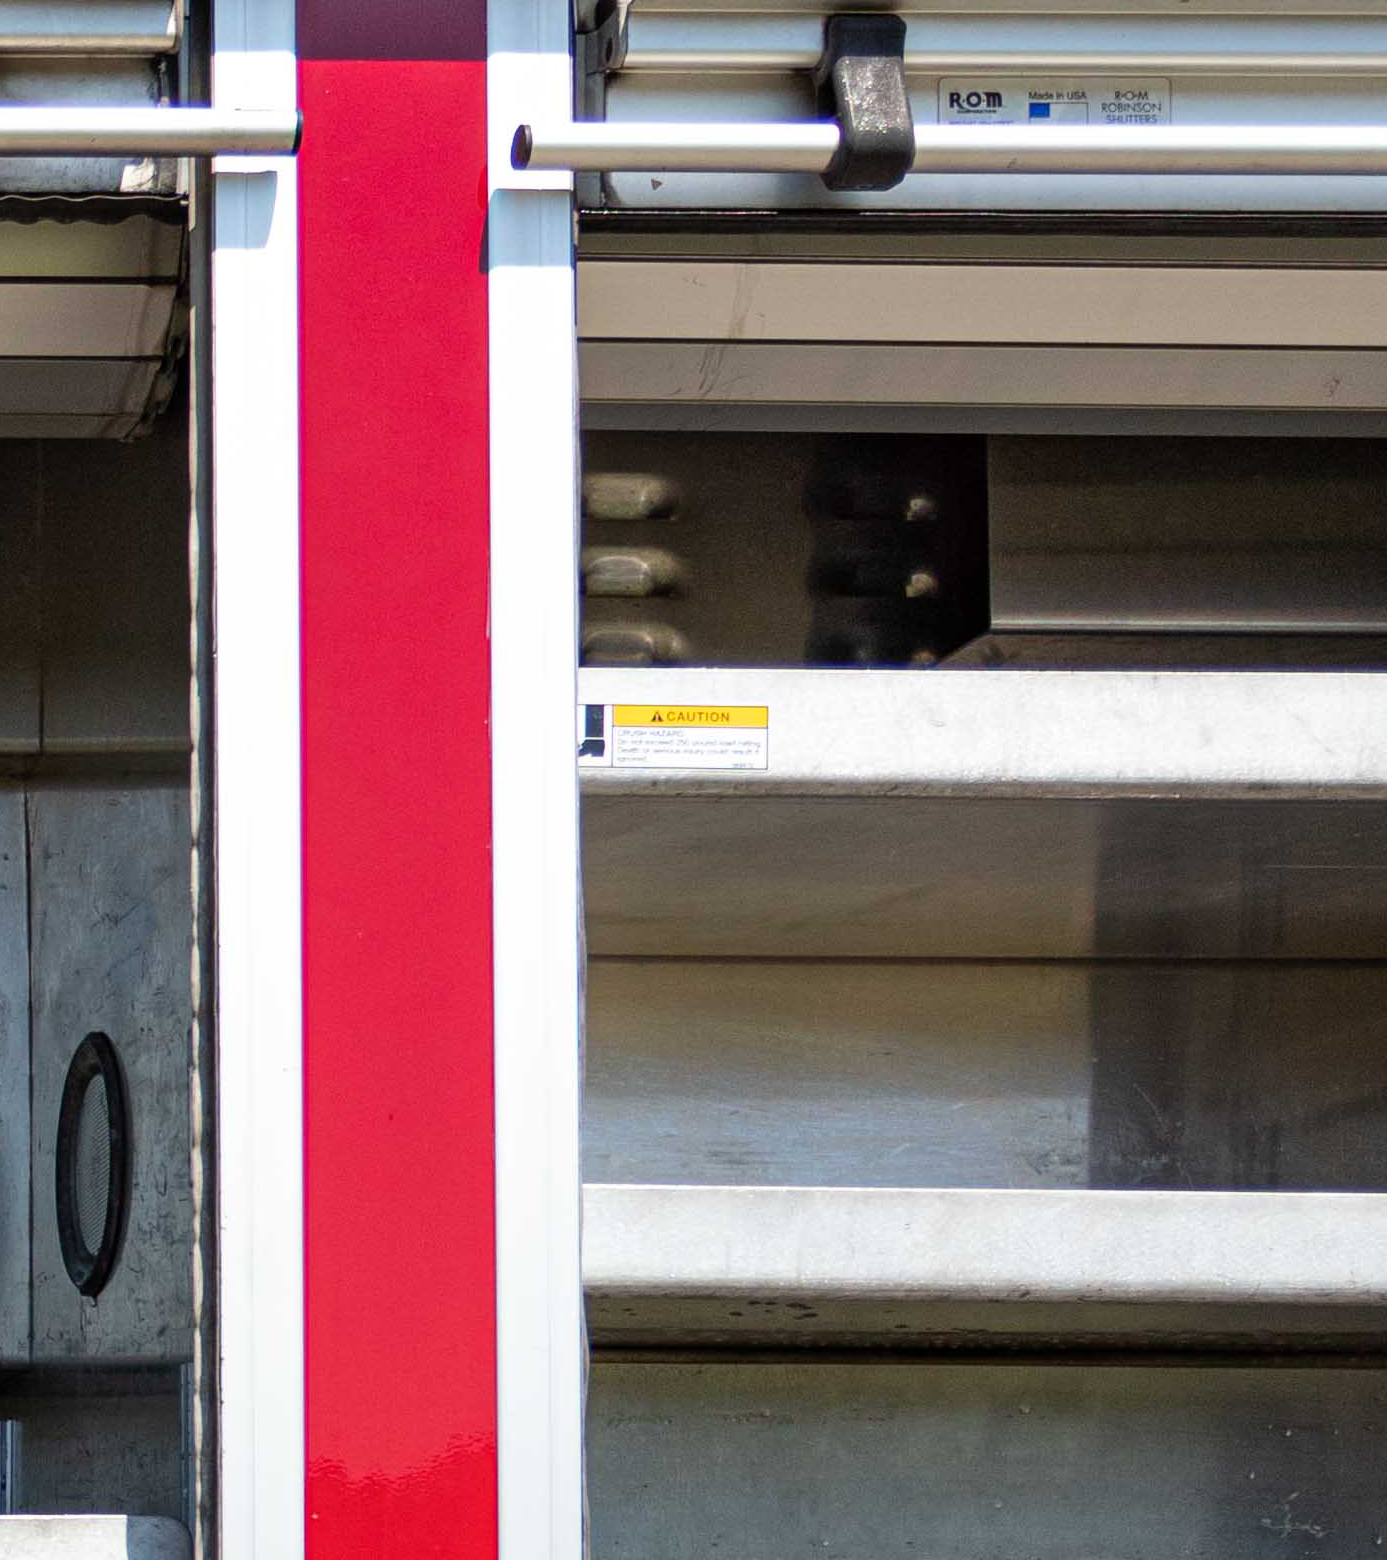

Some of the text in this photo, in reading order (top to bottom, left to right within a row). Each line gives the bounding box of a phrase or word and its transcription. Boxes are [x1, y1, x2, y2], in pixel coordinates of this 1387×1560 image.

[1066, 91, 1087, 100] USA
[1101, 102, 1162, 112] ROBINSON
[666, 711, 730, 722] CAUTION
